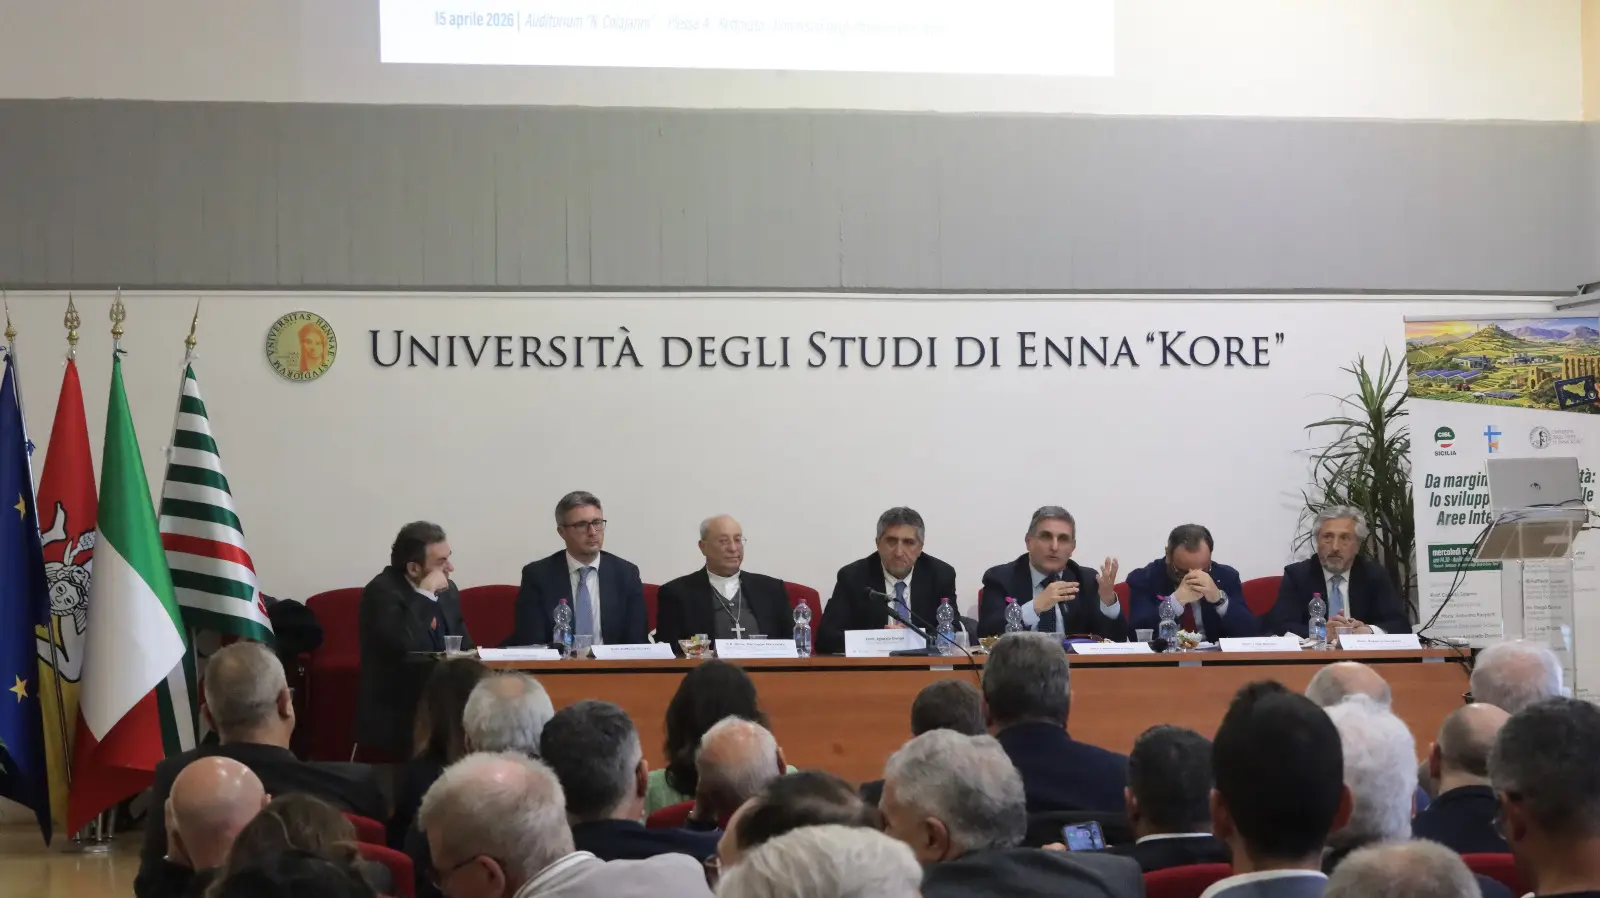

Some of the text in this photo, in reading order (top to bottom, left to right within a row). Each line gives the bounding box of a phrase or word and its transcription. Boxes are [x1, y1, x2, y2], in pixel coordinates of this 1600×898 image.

[435, 11, 446, 26] 15
[449, 11, 484, 29] aprile
[486, 12, 514, 27] 2026
[369, 326, 644, 368] UNIVERSITÀ
[661, 335, 790, 368] DEGLI
[807, 331, 937, 368] STUDI
[954, 335, 1001, 368] DI
[1017, 331, 1140, 367] ENNA
[1424, 467, 1596, 490] Da margin tà:
[1429, 491, 1442, 507] lo
[1443, 490, 1490, 509] svilupp
[1436, 509, 1493, 526] Aree Inte
